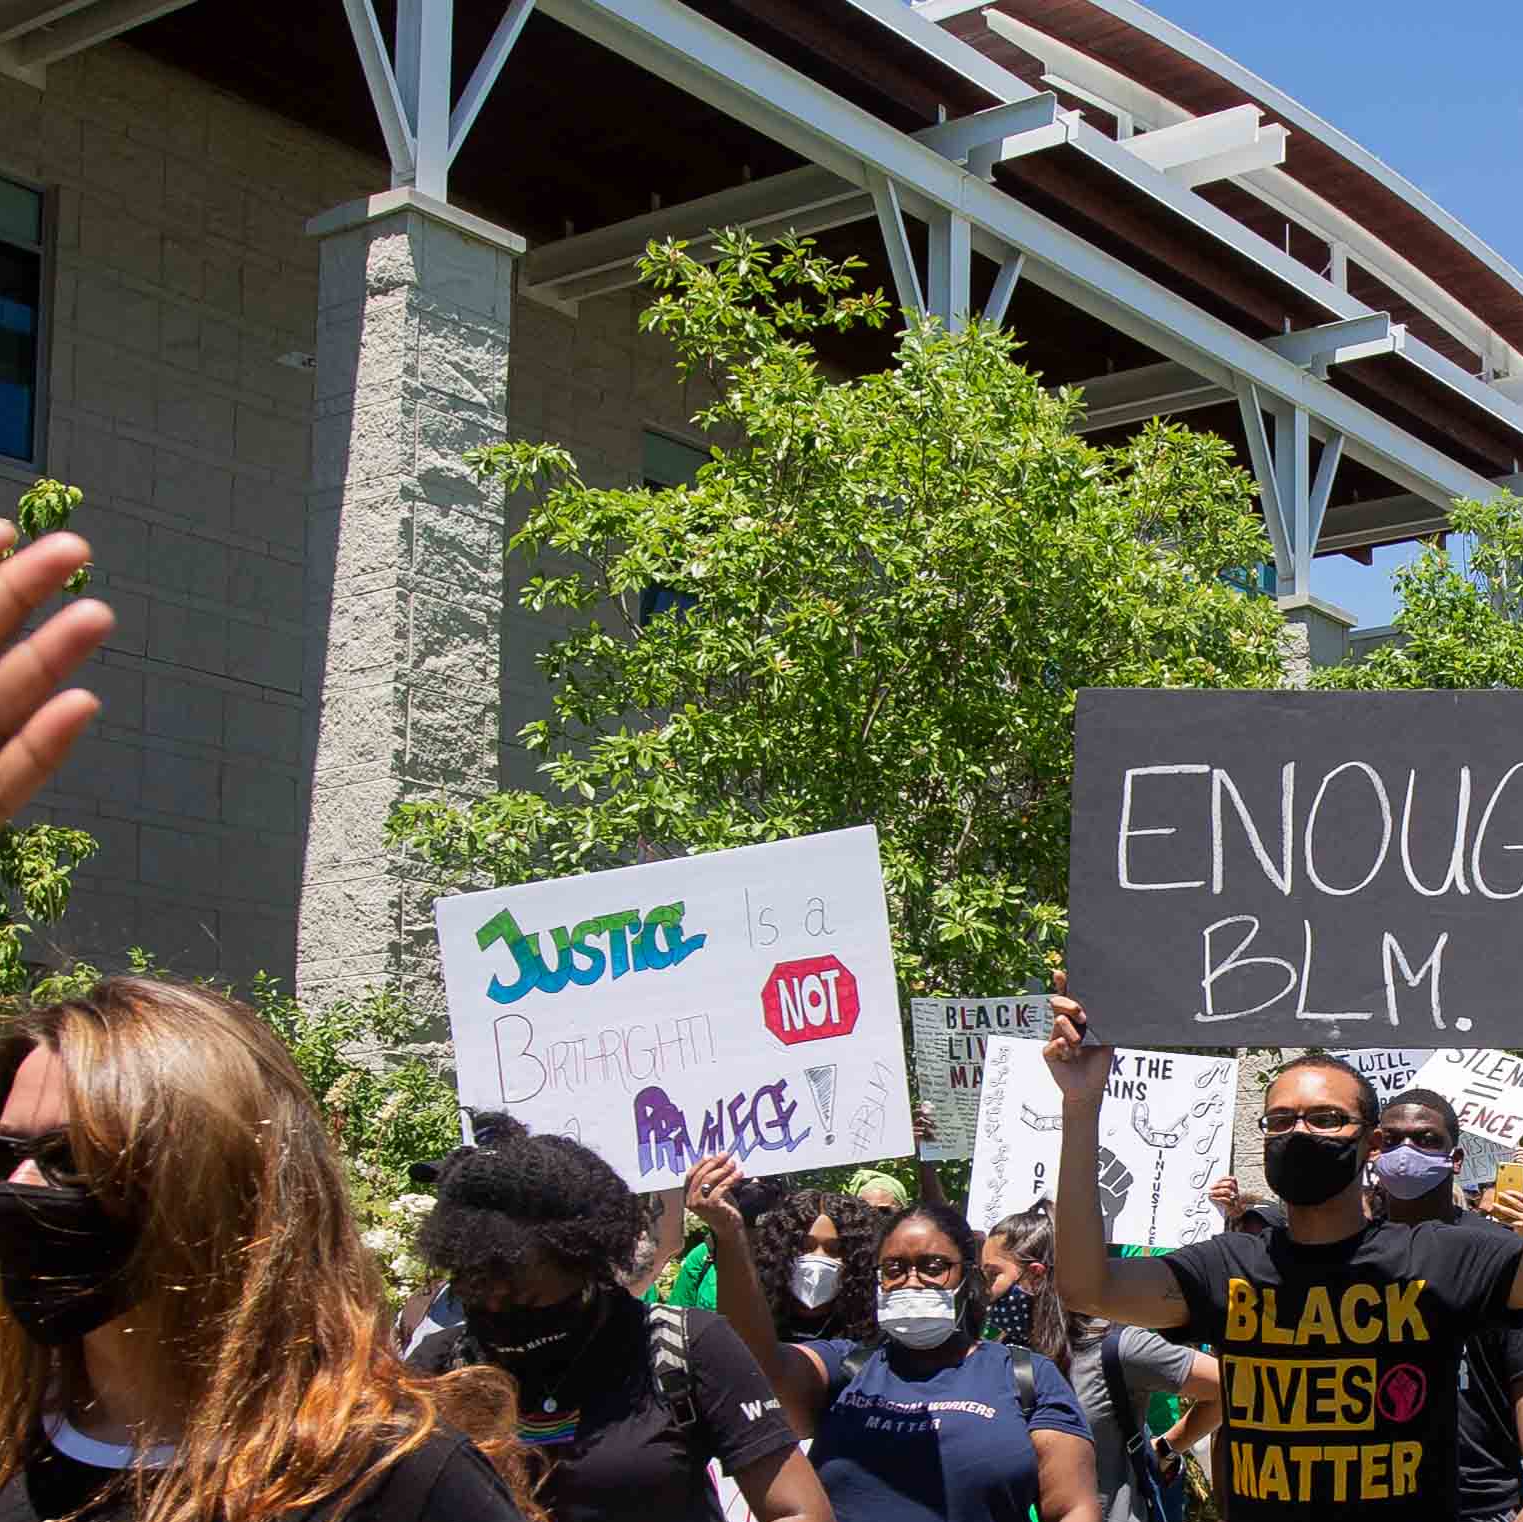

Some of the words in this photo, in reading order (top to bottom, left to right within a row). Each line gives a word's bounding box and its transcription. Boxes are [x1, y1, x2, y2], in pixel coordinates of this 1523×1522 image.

[804, 895, 836, 938] a
[1194, 915, 1472, 1031] BLM.
[776, 968, 843, 1033] NOT
[946, 1003, 1030, 1030] BLACK
[1135, 1057, 1173, 1080] THE
[1358, 1052, 1410, 1072] WILL
[1033, 1162, 1045, 1194] OF
[1225, 1277, 1431, 1345] BLACK
[927, 1400, 996, 1419] WORKERS
[1224, 1362, 1375, 1425] LIVES
[865, 1415, 942, 1432] MATTER
[1231, 1441, 1423, 1501] MATTER
